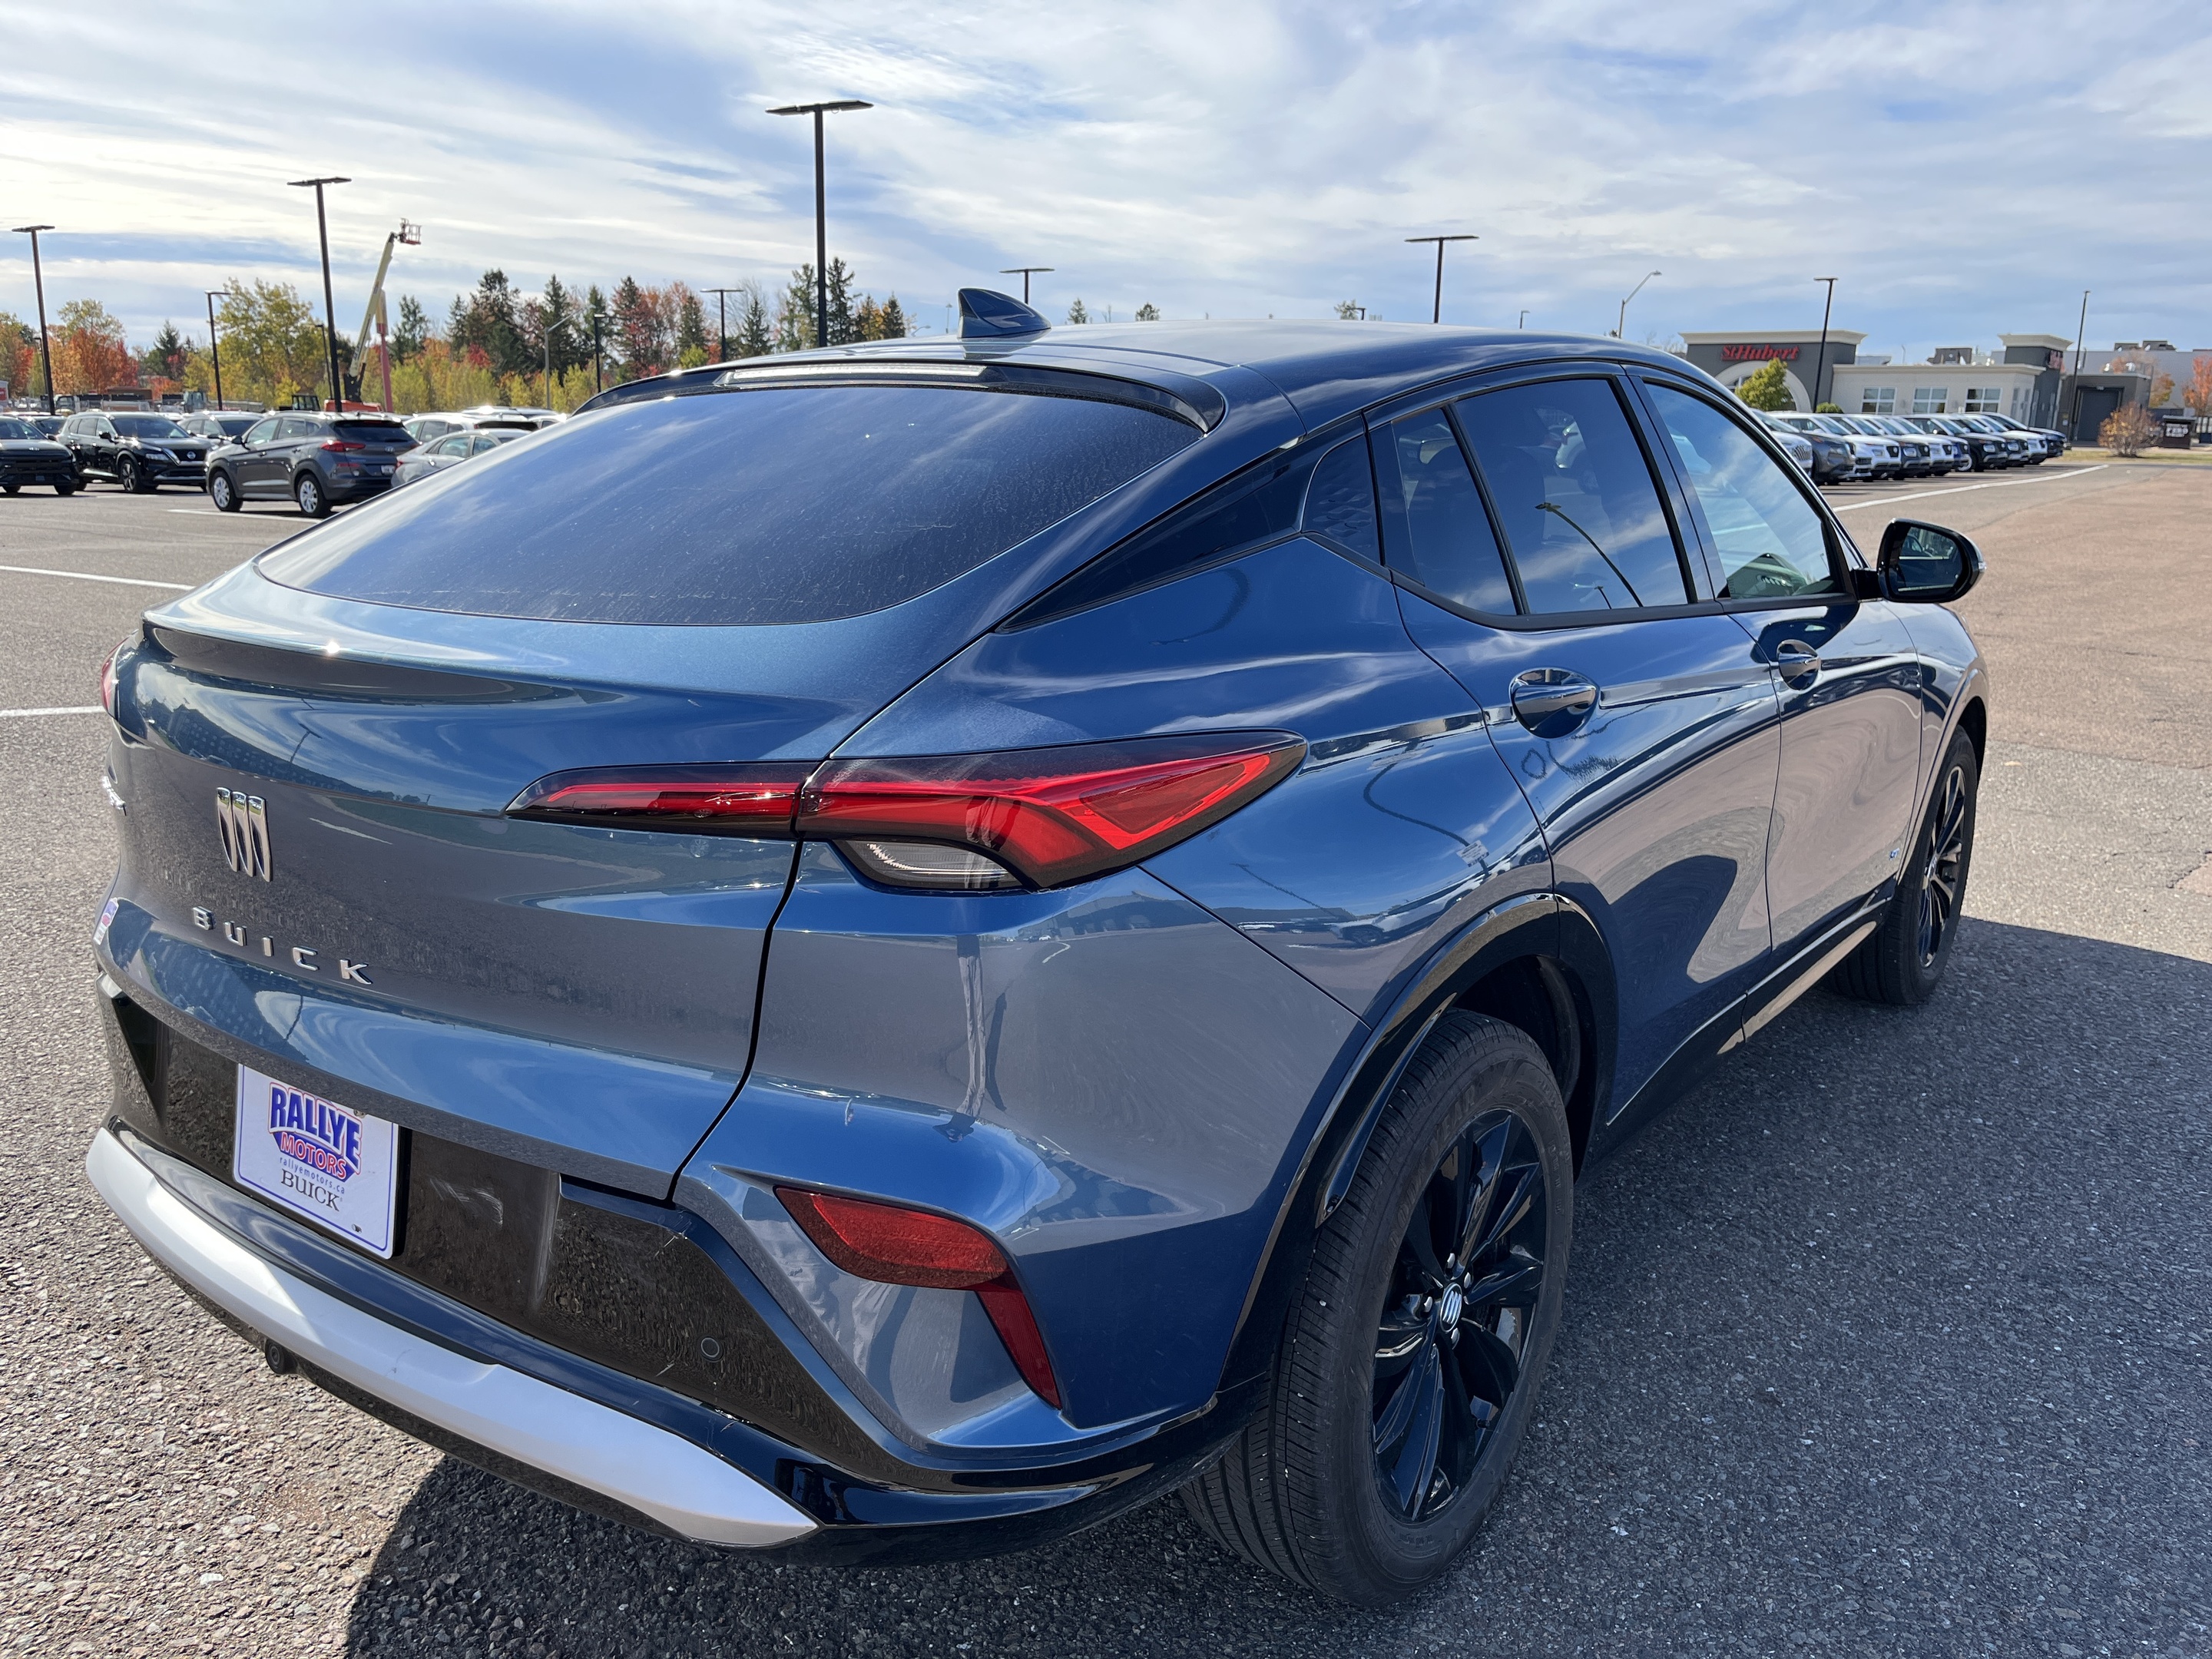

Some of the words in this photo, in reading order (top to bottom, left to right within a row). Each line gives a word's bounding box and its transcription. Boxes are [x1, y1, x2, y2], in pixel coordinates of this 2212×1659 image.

[192, 906, 373, 985] BUICK
[269, 1084, 362, 1172] RALLYE
[280, 1132, 347, 1180] MOTORS
[280, 1157, 345, 1194] rallyemotors.ca
[280, 1168, 340, 1212] BUICK
